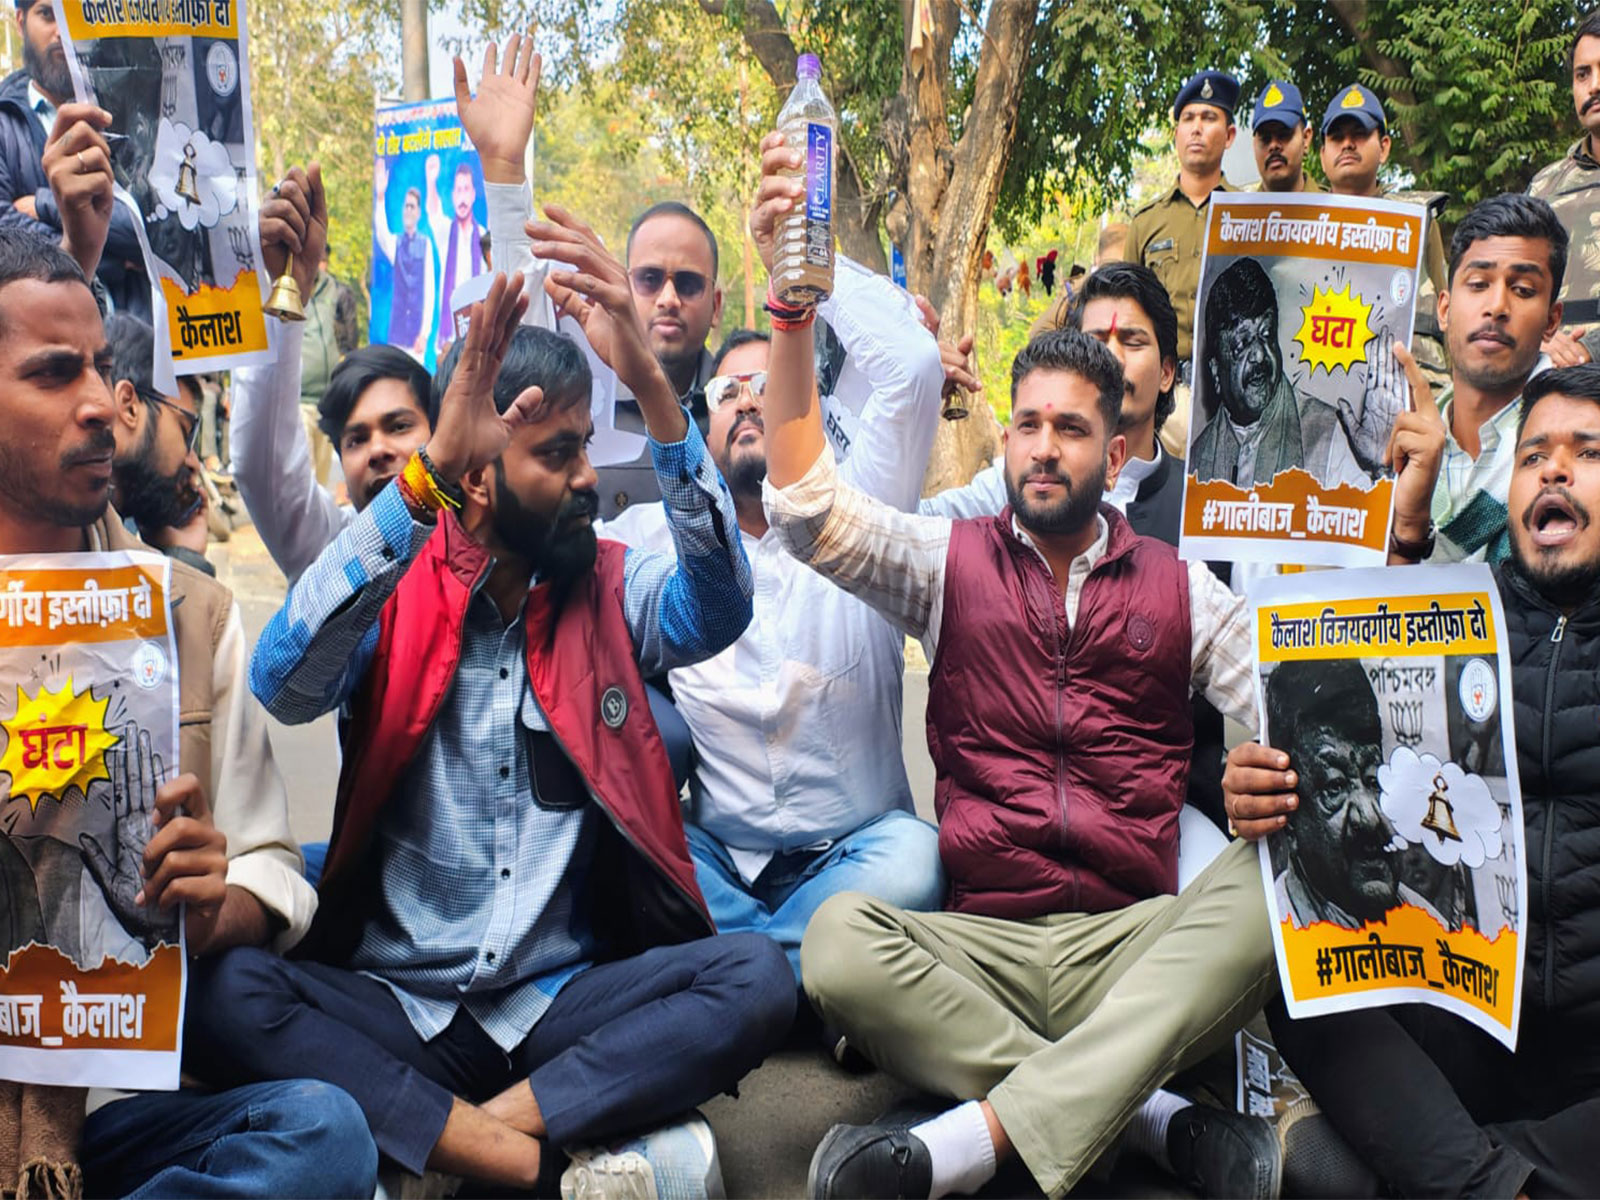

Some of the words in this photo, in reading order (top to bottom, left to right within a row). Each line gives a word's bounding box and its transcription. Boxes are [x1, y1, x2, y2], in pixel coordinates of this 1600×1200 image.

[813, 132, 827, 206] CLARITY
[1220, 211, 1264, 243] कैलाश
[1265, 212, 1340, 248] विजयवर्गीय
[1340, 217, 1395, 253] इस्तीफ़ा
[1396, 221, 1412, 254] दो
[1310, 305, 1357, 349] घंटा
[1202, 492, 1368, 538] #गालीबाज_कैलाश
[46, 578, 130, 631] इस्तीफ़ा
[131, 575, 152, 620] दो
[1271, 613, 1317, 650] कैलाश
[1319, 602, 1402, 647] विजयवर्गीय
[1404, 601, 1466, 646] इस्तीफ़ा
[1466, 600, 1488, 640] दो
[18, 713, 89, 771] घंटा
[1315, 932, 1499, 1007] #गालीबाज_कैलाश
